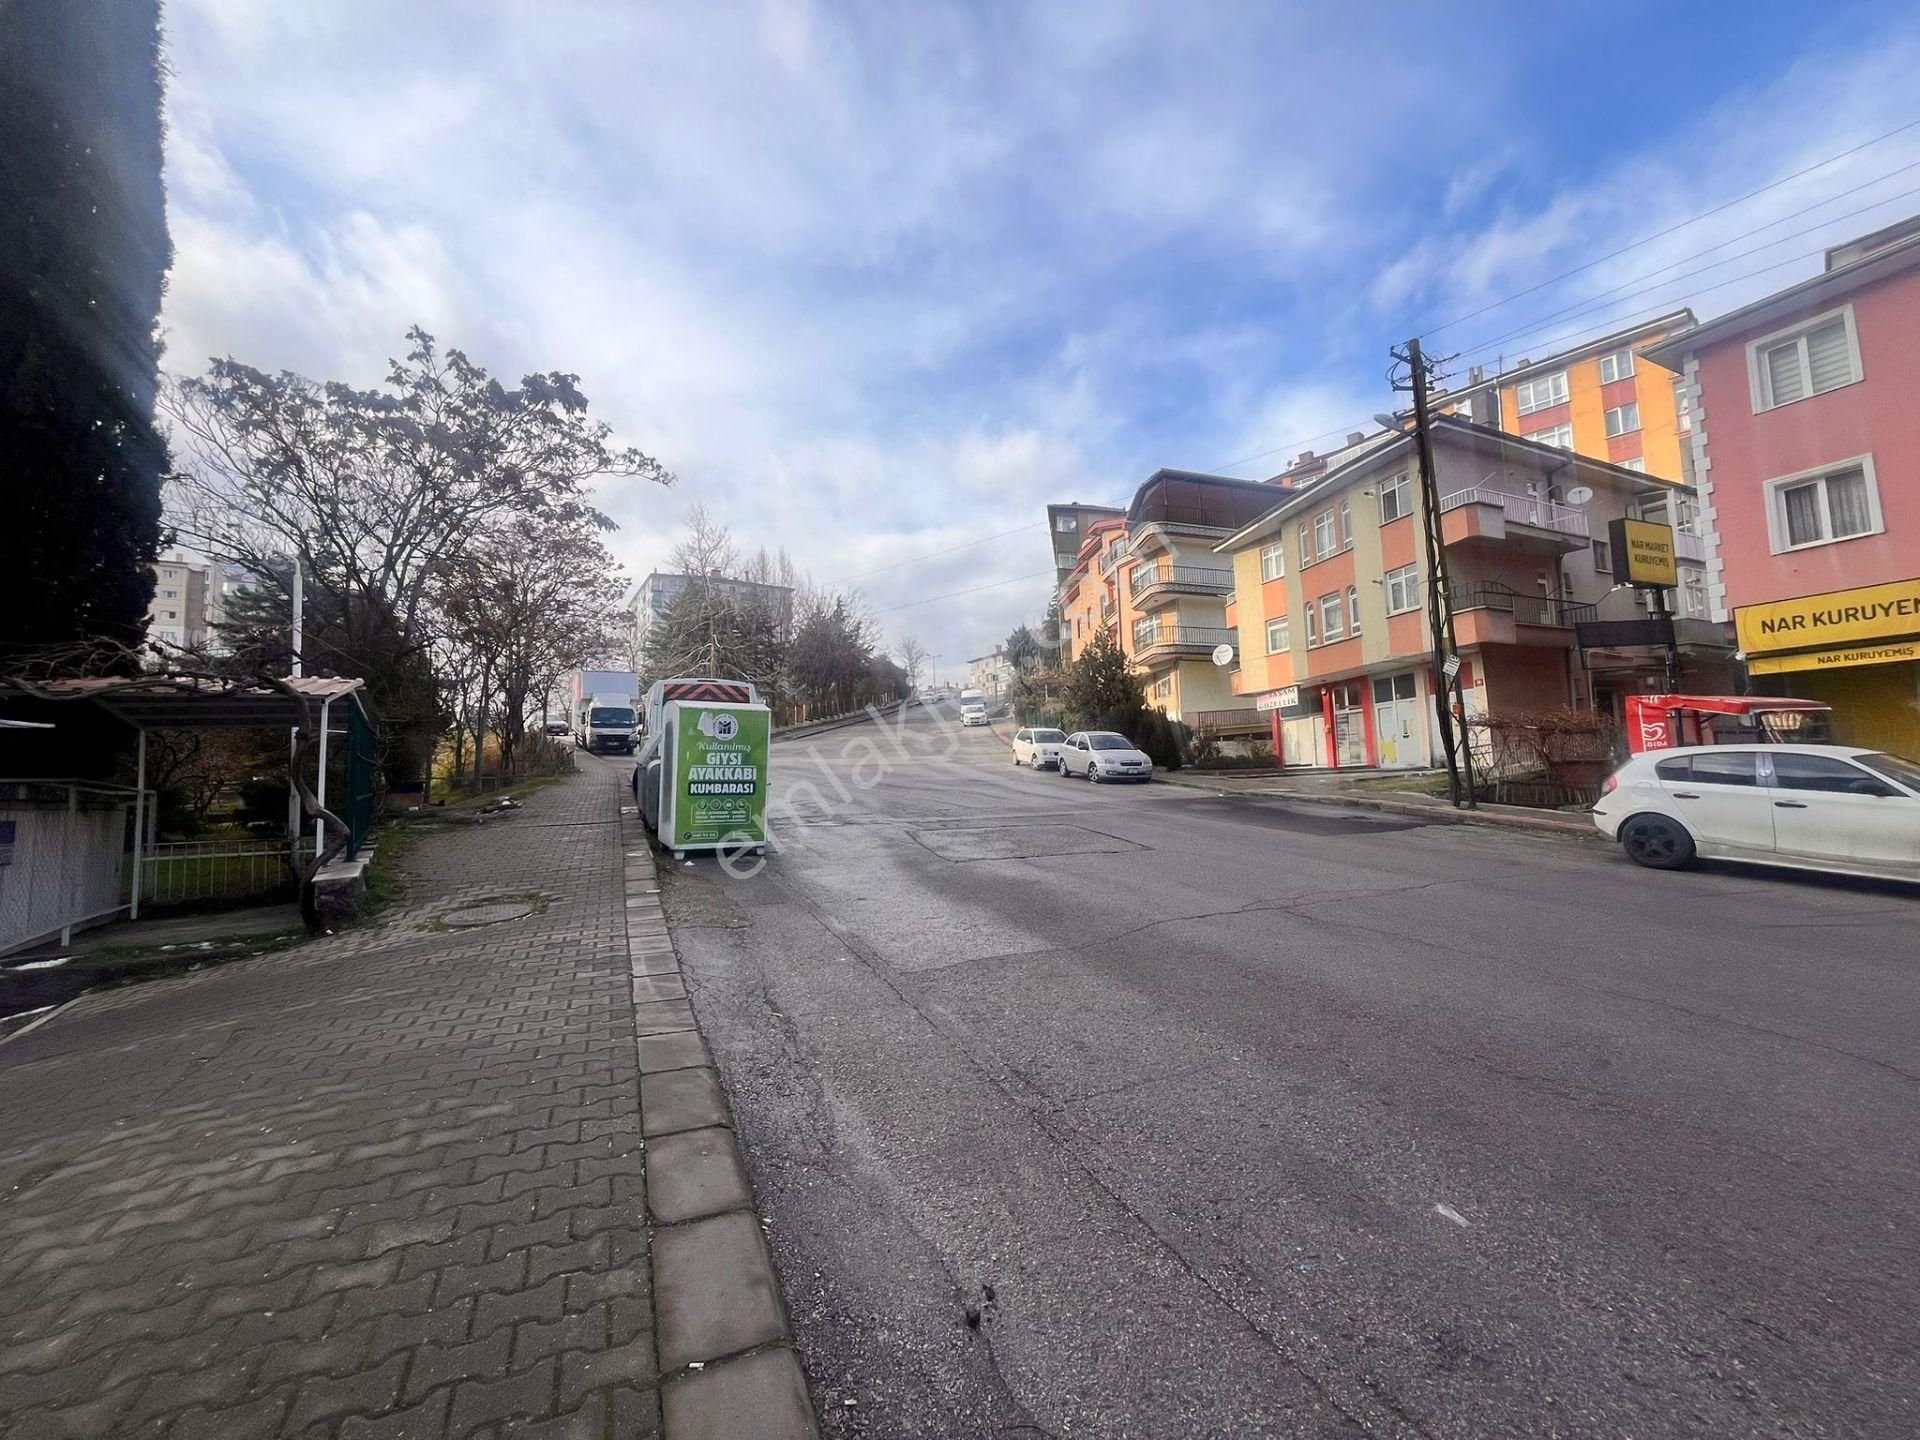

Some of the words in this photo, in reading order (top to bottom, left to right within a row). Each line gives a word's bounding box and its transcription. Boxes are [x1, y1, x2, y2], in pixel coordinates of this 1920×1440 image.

[1631, 539, 1645, 550] NAR
[1645, 542, 1669, 554] MARKET
[1761, 614, 1806, 635] NAR
[1817, 654, 1841, 665] NAR
[688, 767, 757, 780] AYAKKABI
[690, 783, 754, 794] KUMBARASI
